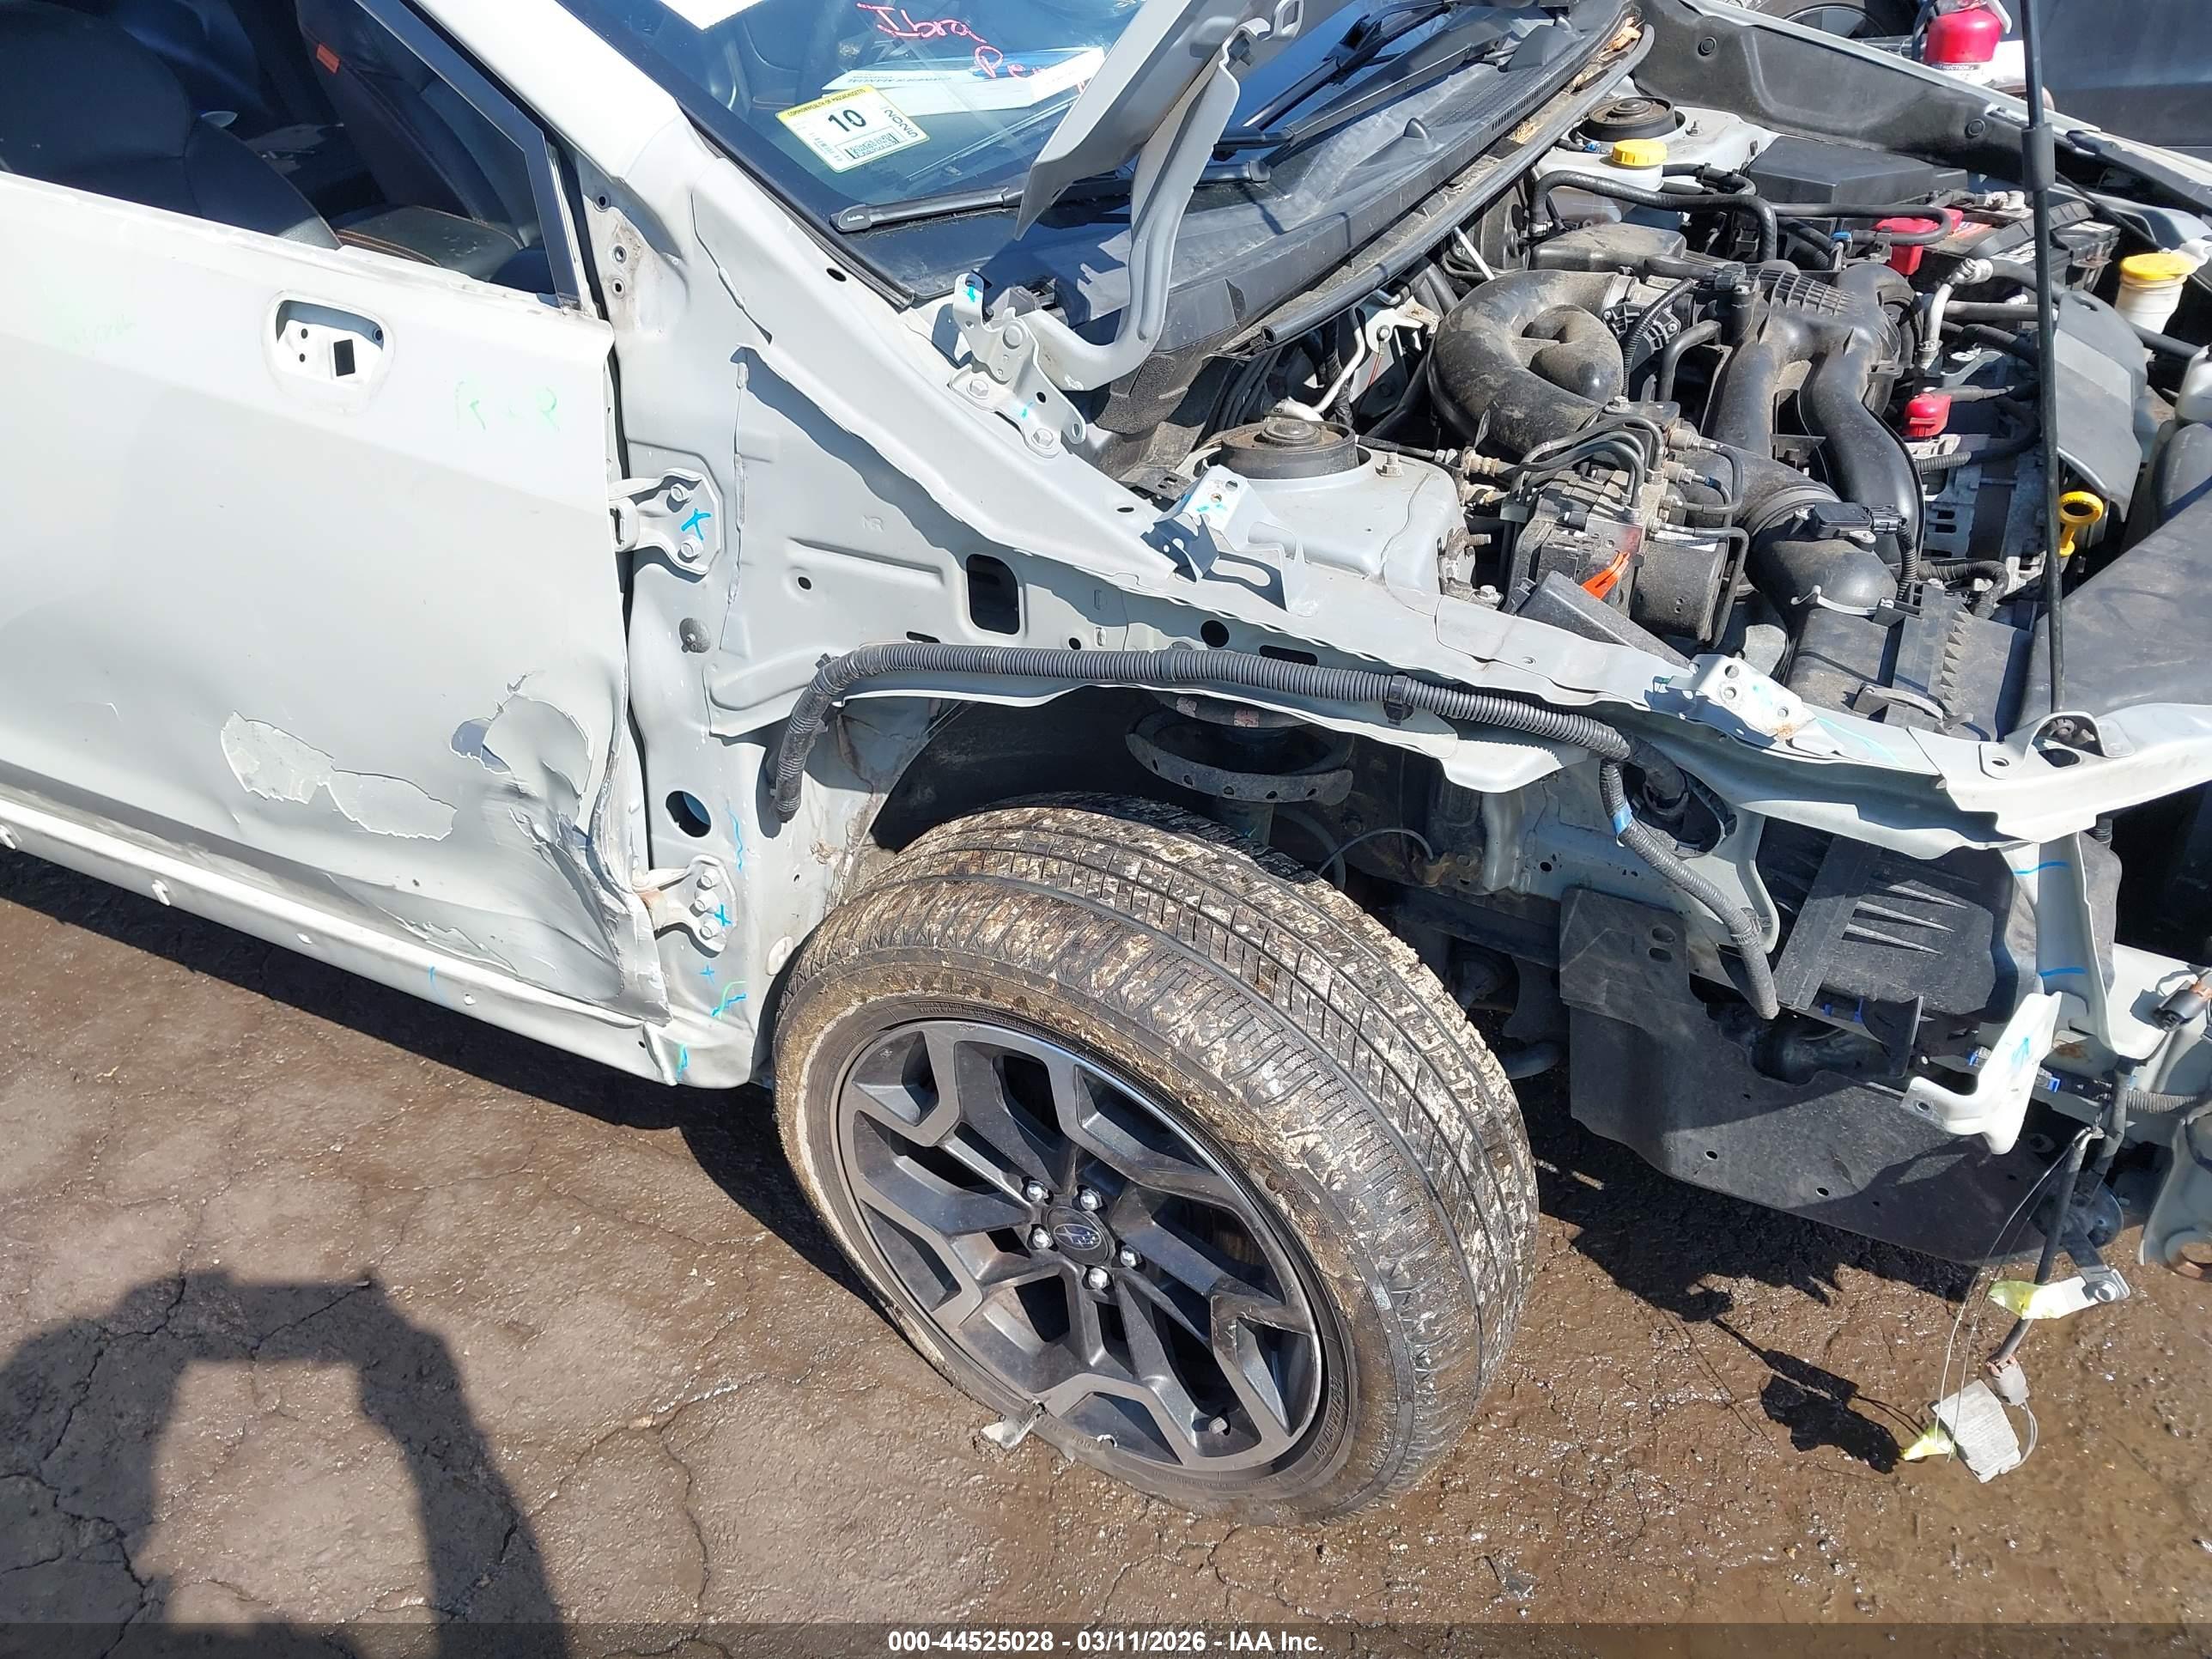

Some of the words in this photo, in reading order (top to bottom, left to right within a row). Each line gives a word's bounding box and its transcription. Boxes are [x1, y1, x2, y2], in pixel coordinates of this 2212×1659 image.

[787, 100, 825, 118] COMMONWEALTH
[828, 109, 866, 132] 10
[884, 109, 918, 138] 2025
